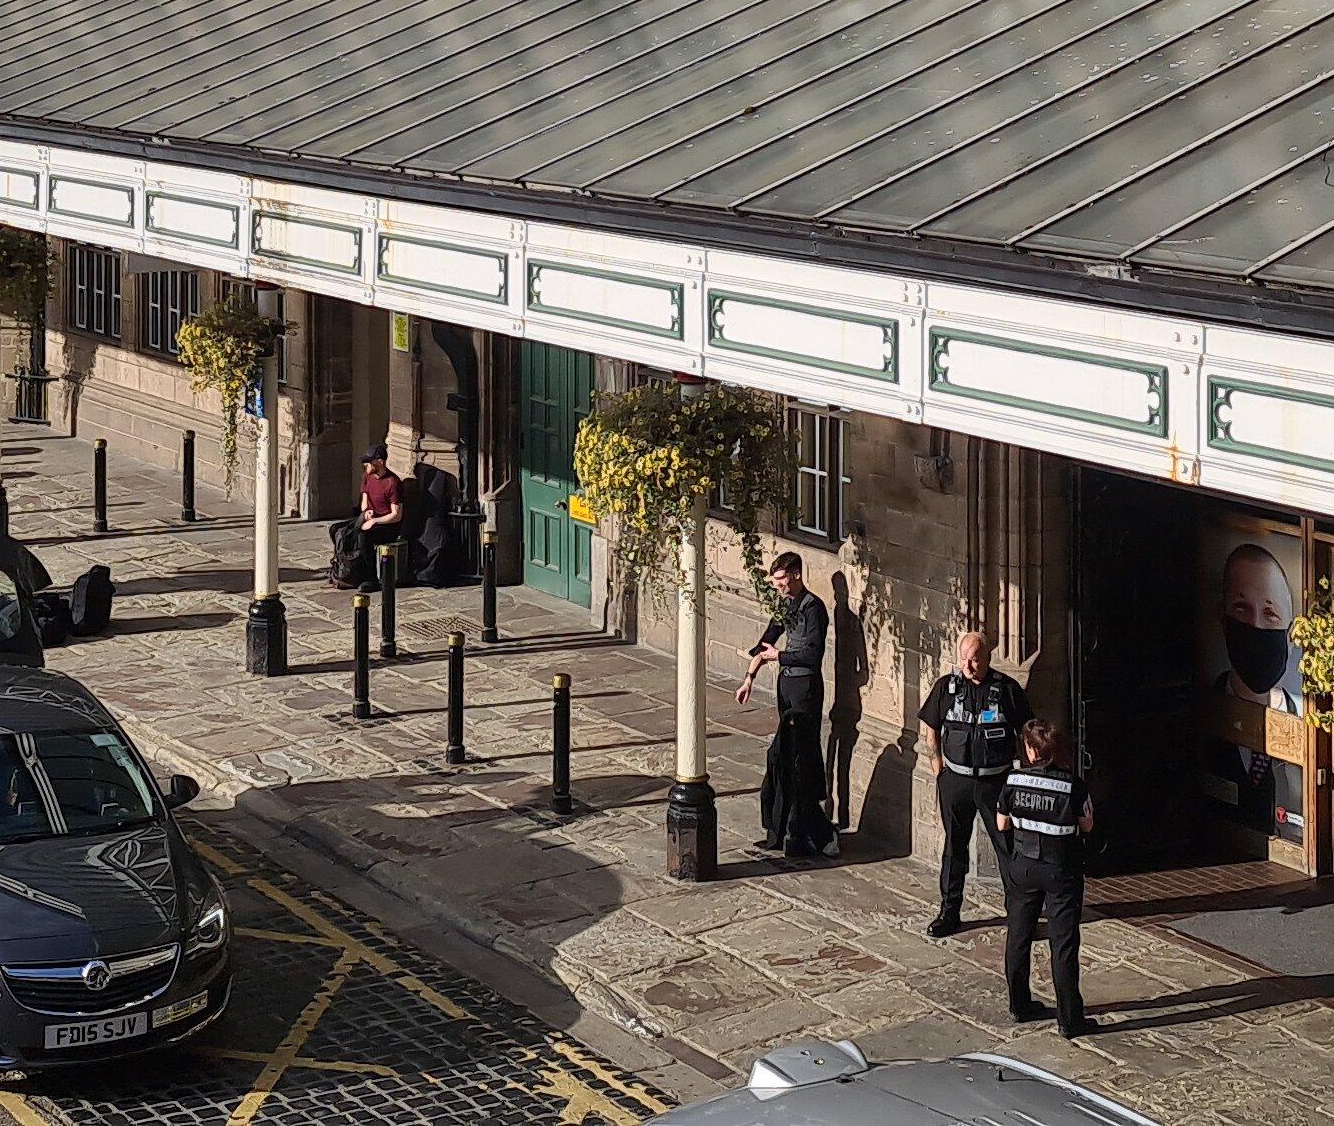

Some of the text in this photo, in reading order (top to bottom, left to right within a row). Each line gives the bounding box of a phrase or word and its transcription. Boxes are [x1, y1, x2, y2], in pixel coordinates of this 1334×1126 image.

[1014, 790, 1055, 811] SECURITY
[56, 1016, 137, 1046] FD15 SJV
